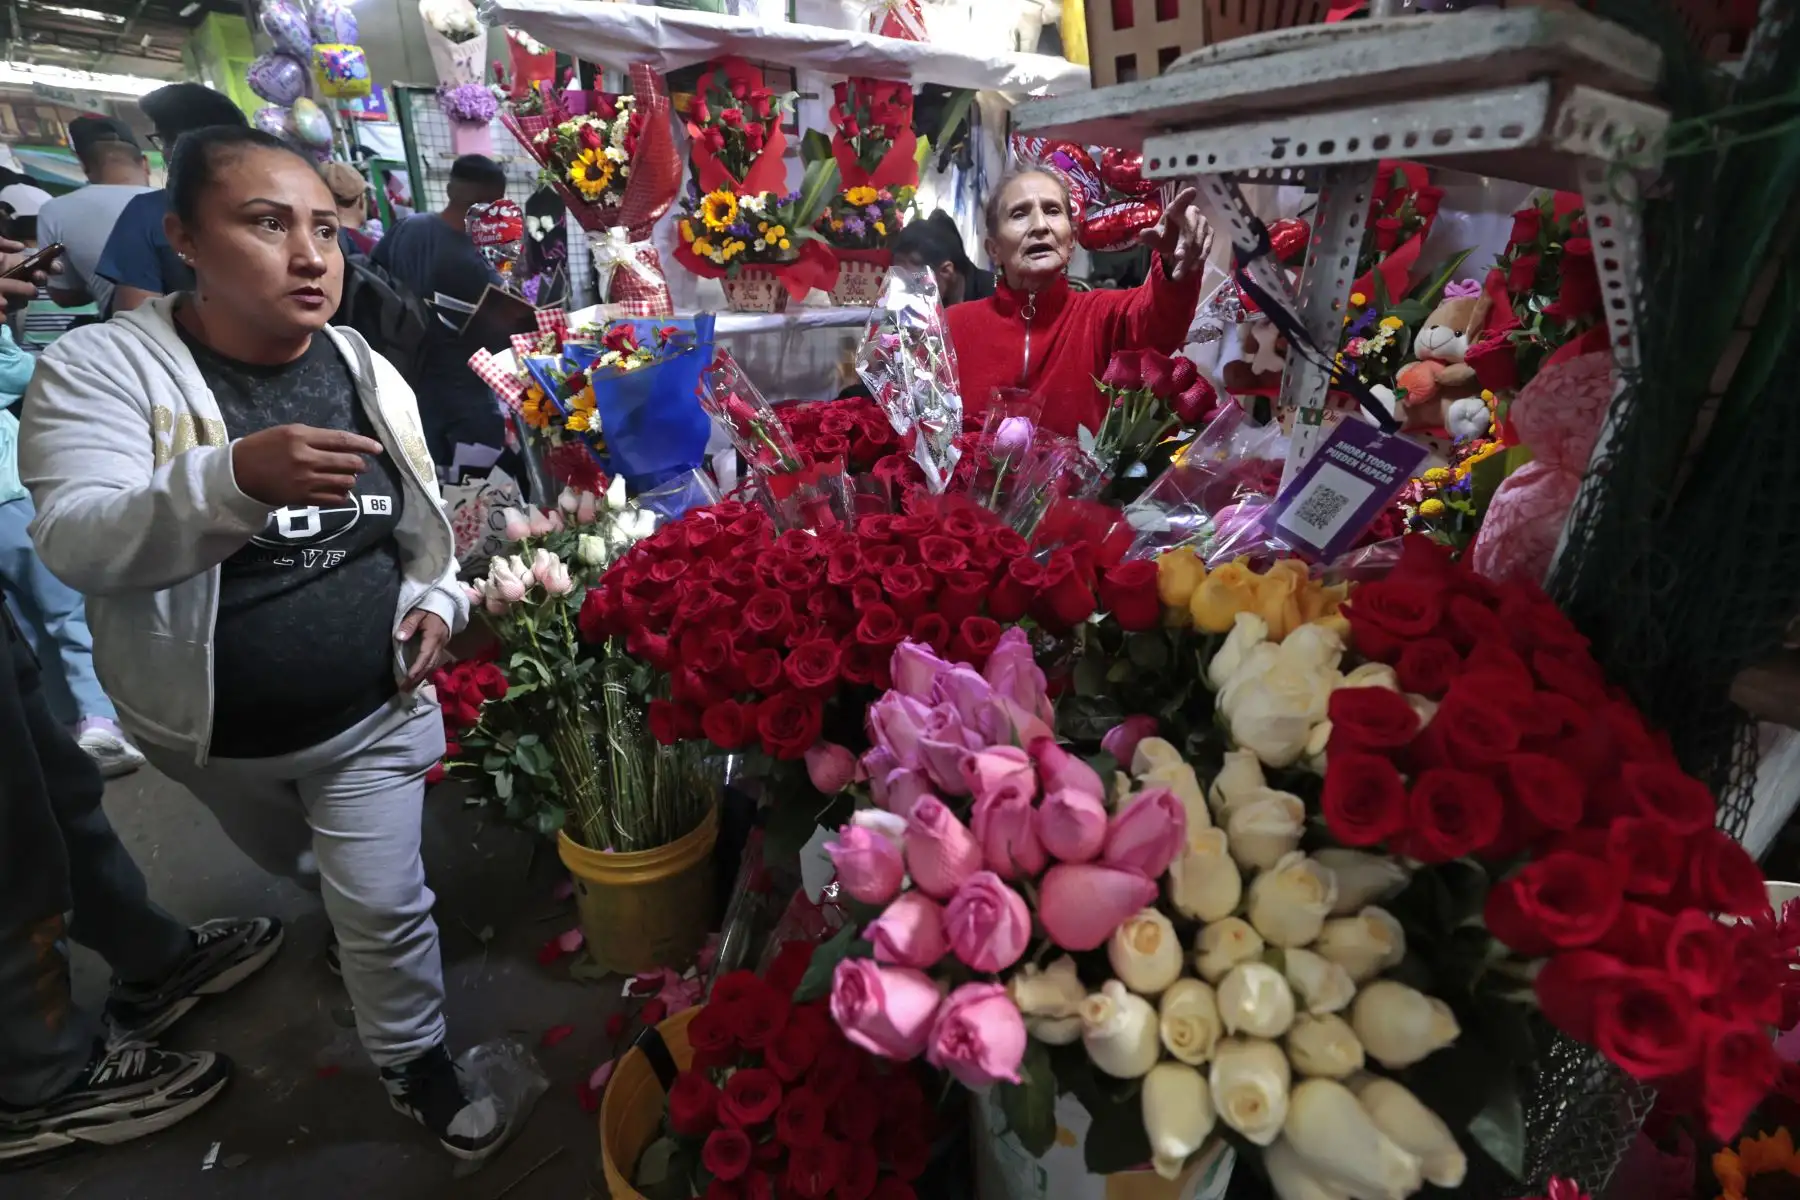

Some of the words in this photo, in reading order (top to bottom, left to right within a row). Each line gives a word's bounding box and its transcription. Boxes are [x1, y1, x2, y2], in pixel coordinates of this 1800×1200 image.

[1325, 447, 1361, 469] PUEDEN
[1358, 462, 1394, 485] YAPEAR
[1335, 441, 1367, 462] AHORA
[1365, 451, 1398, 474] TODOS
[370, 498, 387, 511] 86
